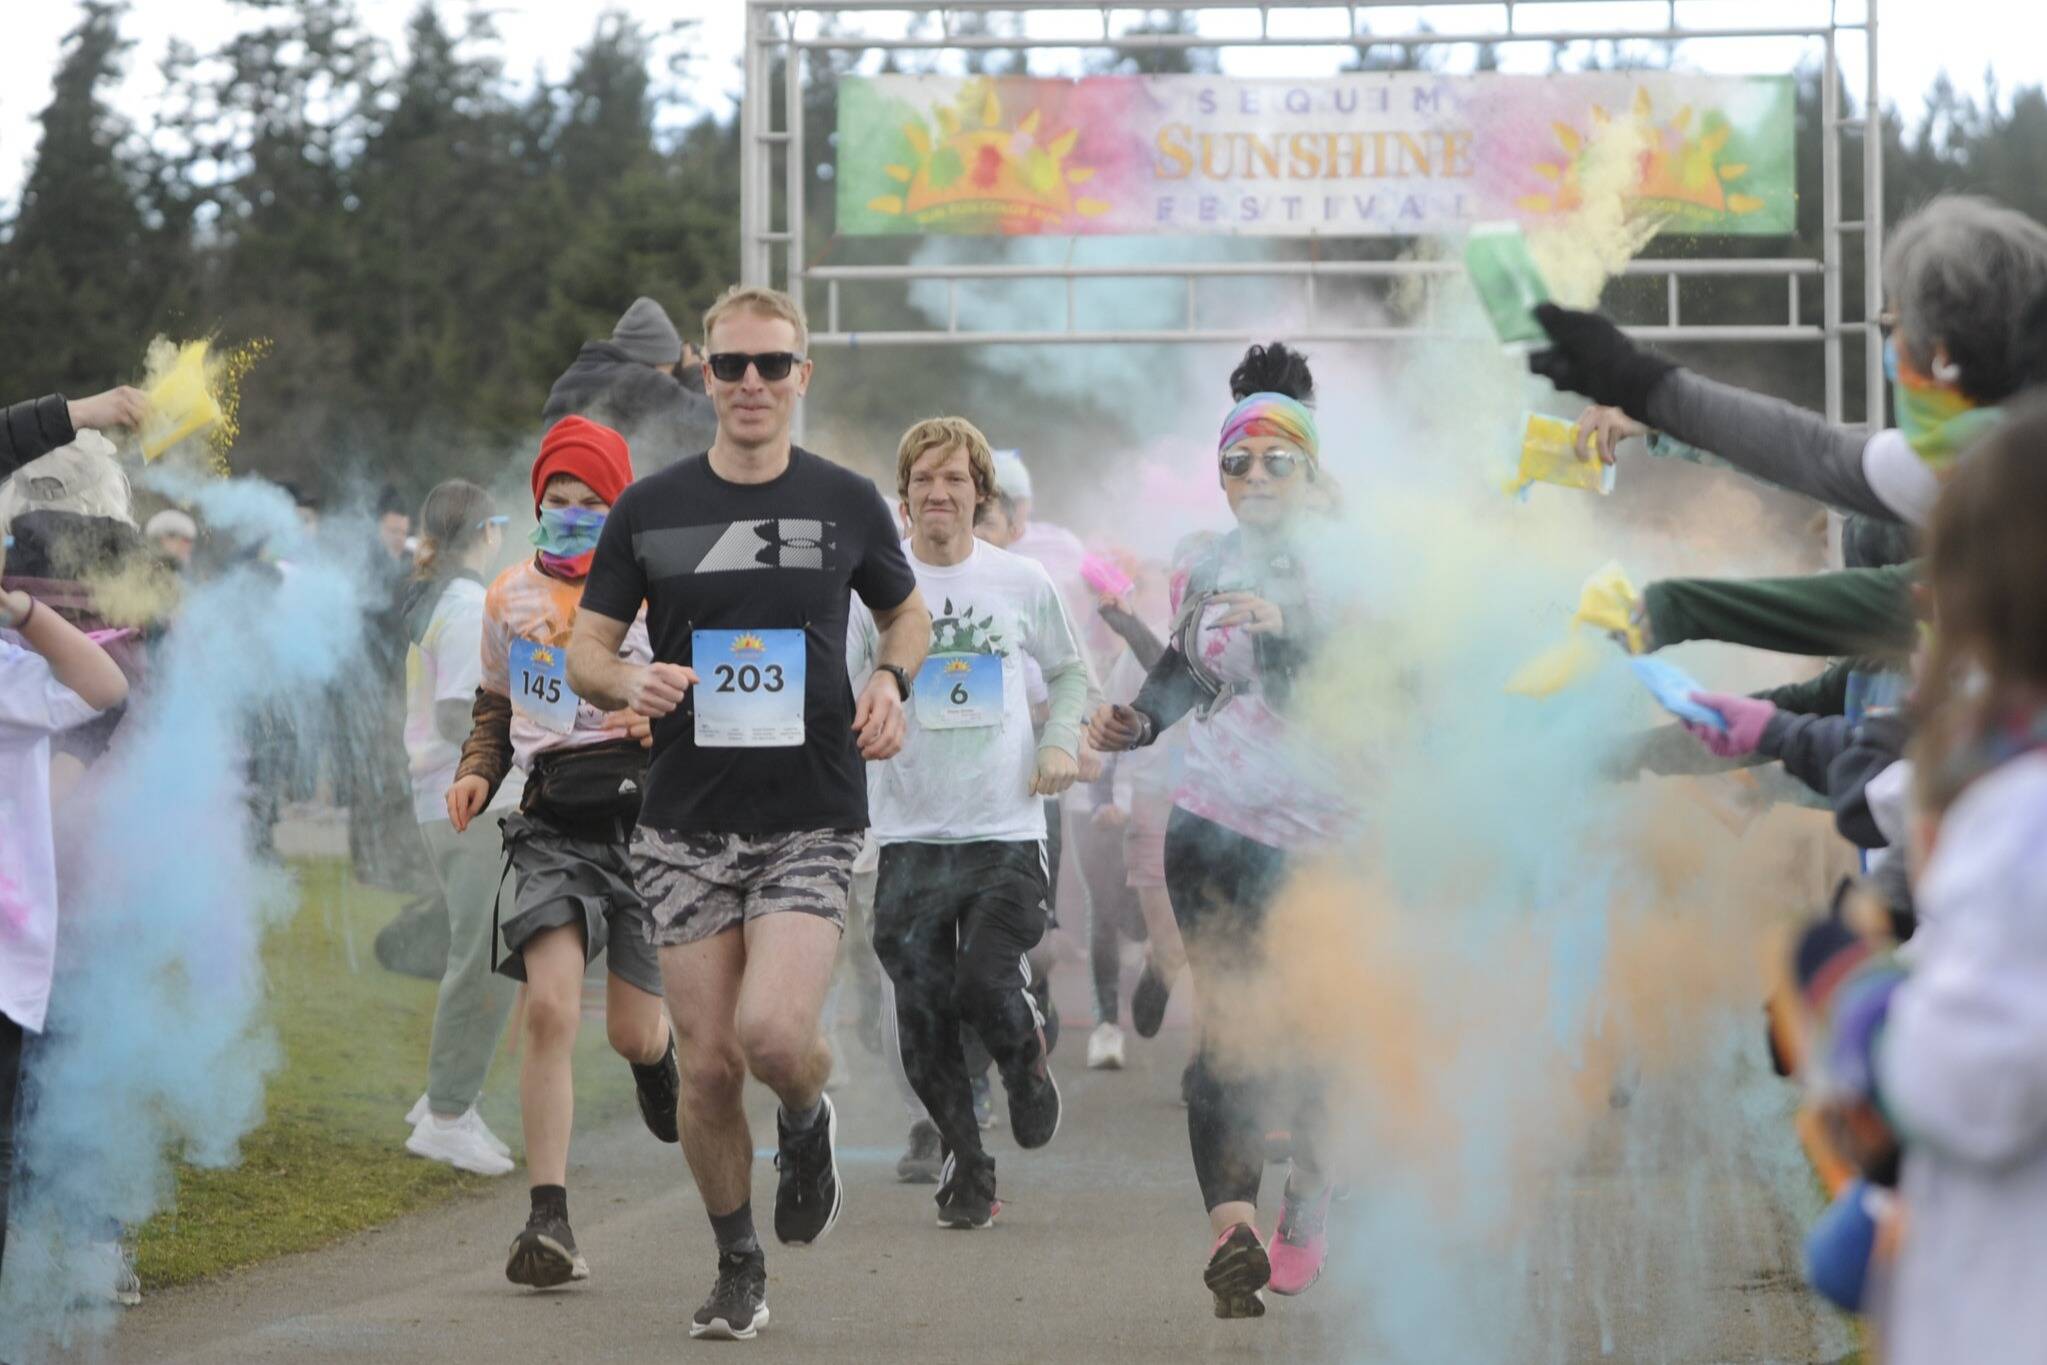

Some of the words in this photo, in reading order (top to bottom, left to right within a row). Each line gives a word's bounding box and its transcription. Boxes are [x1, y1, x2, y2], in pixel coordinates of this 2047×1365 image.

[1200, 88, 1440, 115] SEQUIM
[1155, 123, 1475, 180] SUNSHINE
[1156, 196, 1471, 221] FESTIVAL
[523, 670, 561, 703] 145
[714, 664, 784, 693] 203
[950, 682, 968, 704] 6
